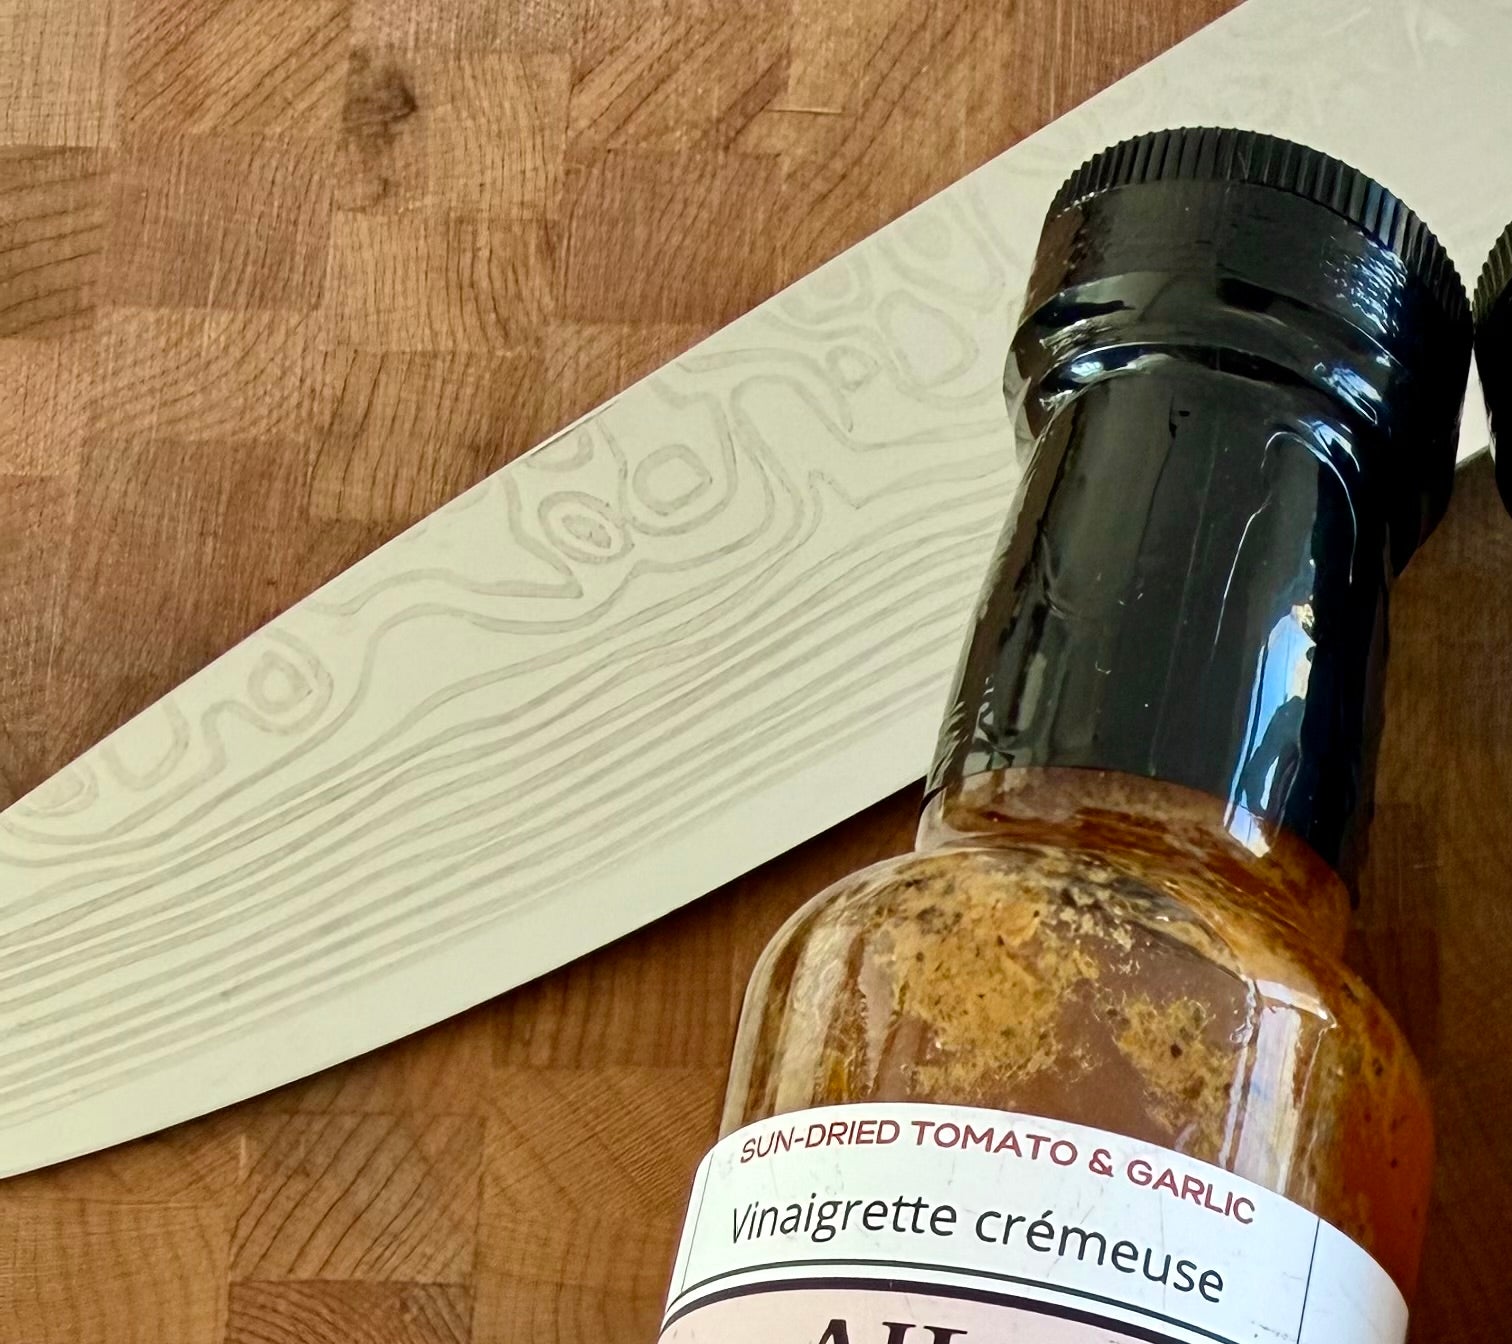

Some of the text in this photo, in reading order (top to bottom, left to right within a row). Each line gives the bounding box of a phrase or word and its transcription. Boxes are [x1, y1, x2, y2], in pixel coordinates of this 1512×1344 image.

[739, 1119, 1256, 1226] SUN-DRIED TOMATO & GARLIC
[729, 1193, 1225, 1304] Vinaigrette crémeuse
